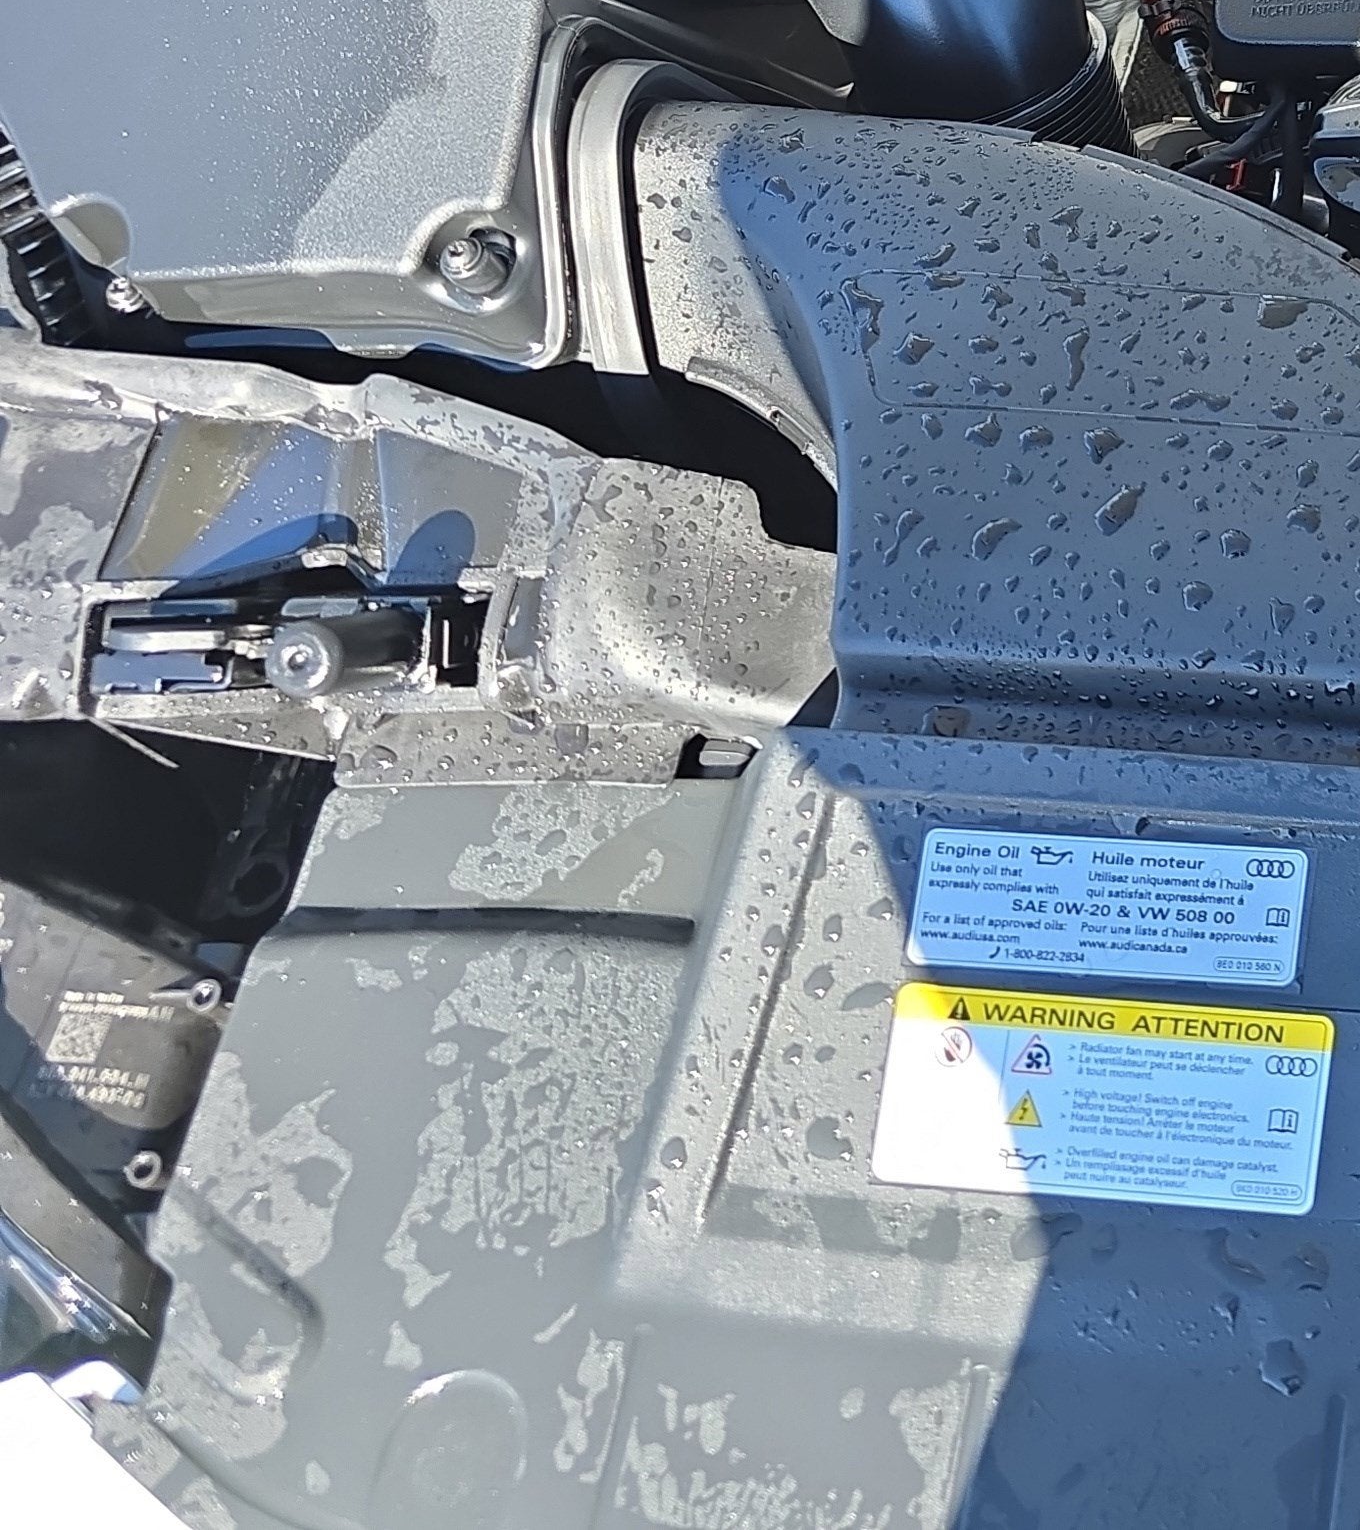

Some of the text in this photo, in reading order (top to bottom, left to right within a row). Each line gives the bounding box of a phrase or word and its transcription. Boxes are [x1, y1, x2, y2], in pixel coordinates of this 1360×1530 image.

[935, 842, 1020, 859] Engine Oil
[930, 861, 1022, 877] Use only oil that
[1092, 852, 1205, 870] Huile moteur
[928, 880, 1059, 895] expressly complies with
[1088, 871, 1254, 891] Utilisez uniquement de l'huile
[1086, 887, 1105, 899] qui
[1107, 888, 1152, 900] satisfait
[1154, 891, 1234, 905] expressément
[1012, 899, 1235, 924] SAE 0W-20 & VW 508 00
[923, 912, 940, 923] For
[954, 914, 971, 926] list
[973, 915, 985, 926] of
[987, 918, 1041, 931] approved
[1044, 920, 1068, 931] oils:
[920, 929, 1021, 944] www.audiusa.com
[1080, 922, 1278, 944] Pour une liste d'huiles approuvées:
[1004, 948, 1085, 963] 1-800-822-2834
[1078, 939, 1188, 954] www.audicanada.ca
[983, 1002, 1285, 1043] WARNING ATTENTION
[1079, 1053, 1091, 1064] Le
[1093, 1055, 1147, 1068] ventilateur
[1150, 1060, 1172, 1071] peut
[1176, 1062, 1187, 1071] se
[1080, 1041, 1123, 1054] Radiator
[1126, 1045, 1142, 1056] fan
[1145, 1048, 1166, 1060] may
[1168, 1050, 1192, 1060] start
[1194, 1052, 1204, 1061] at
[1207, 1054, 1225, 1065] any
[1086, 1066, 1107, 1077] tout
[1073, 1088, 1097, 1102] High
[1145, 1093, 1179, 1106] Switch
[1181, 1095, 1196, 1107] off
[1198, 1099, 1233, 1111] engine
[1072, 1101, 1104, 1112] before
[1107, 1103, 1151, 1117] touching
[1155, 1108, 1190, 1120] engine
[1070, 1112, 1100, 1123] Haute
[1185, 1120, 1195, 1130] le
[1197, 1123, 1234, 1134] moteur
[1069, 1124, 1097, 1135] avant
[1100, 1126, 1112, 1136] de
[1115, 1128, 1154, 1139] toucher
[1238, 1136, 1251, 1147] du
[1067, 1146, 1116, 1160] Overfilled
[1119, 1151, 1153, 1163] engine
[1156, 1153, 1169, 1163] oil
[1171, 1155, 1191, 1166] can
[1193, 1157, 1234, 1170] damage
[1063, 1171, 1087, 1181] peut
[1090, 1172, 1116, 1183] nuire
[1118, 1175, 1131, 1184] au
[1065, 1158, 1081, 1168] Un
[1083, 1160, 1145, 1175] remplissage
[1148, 1165, 1189, 1178] excessif
